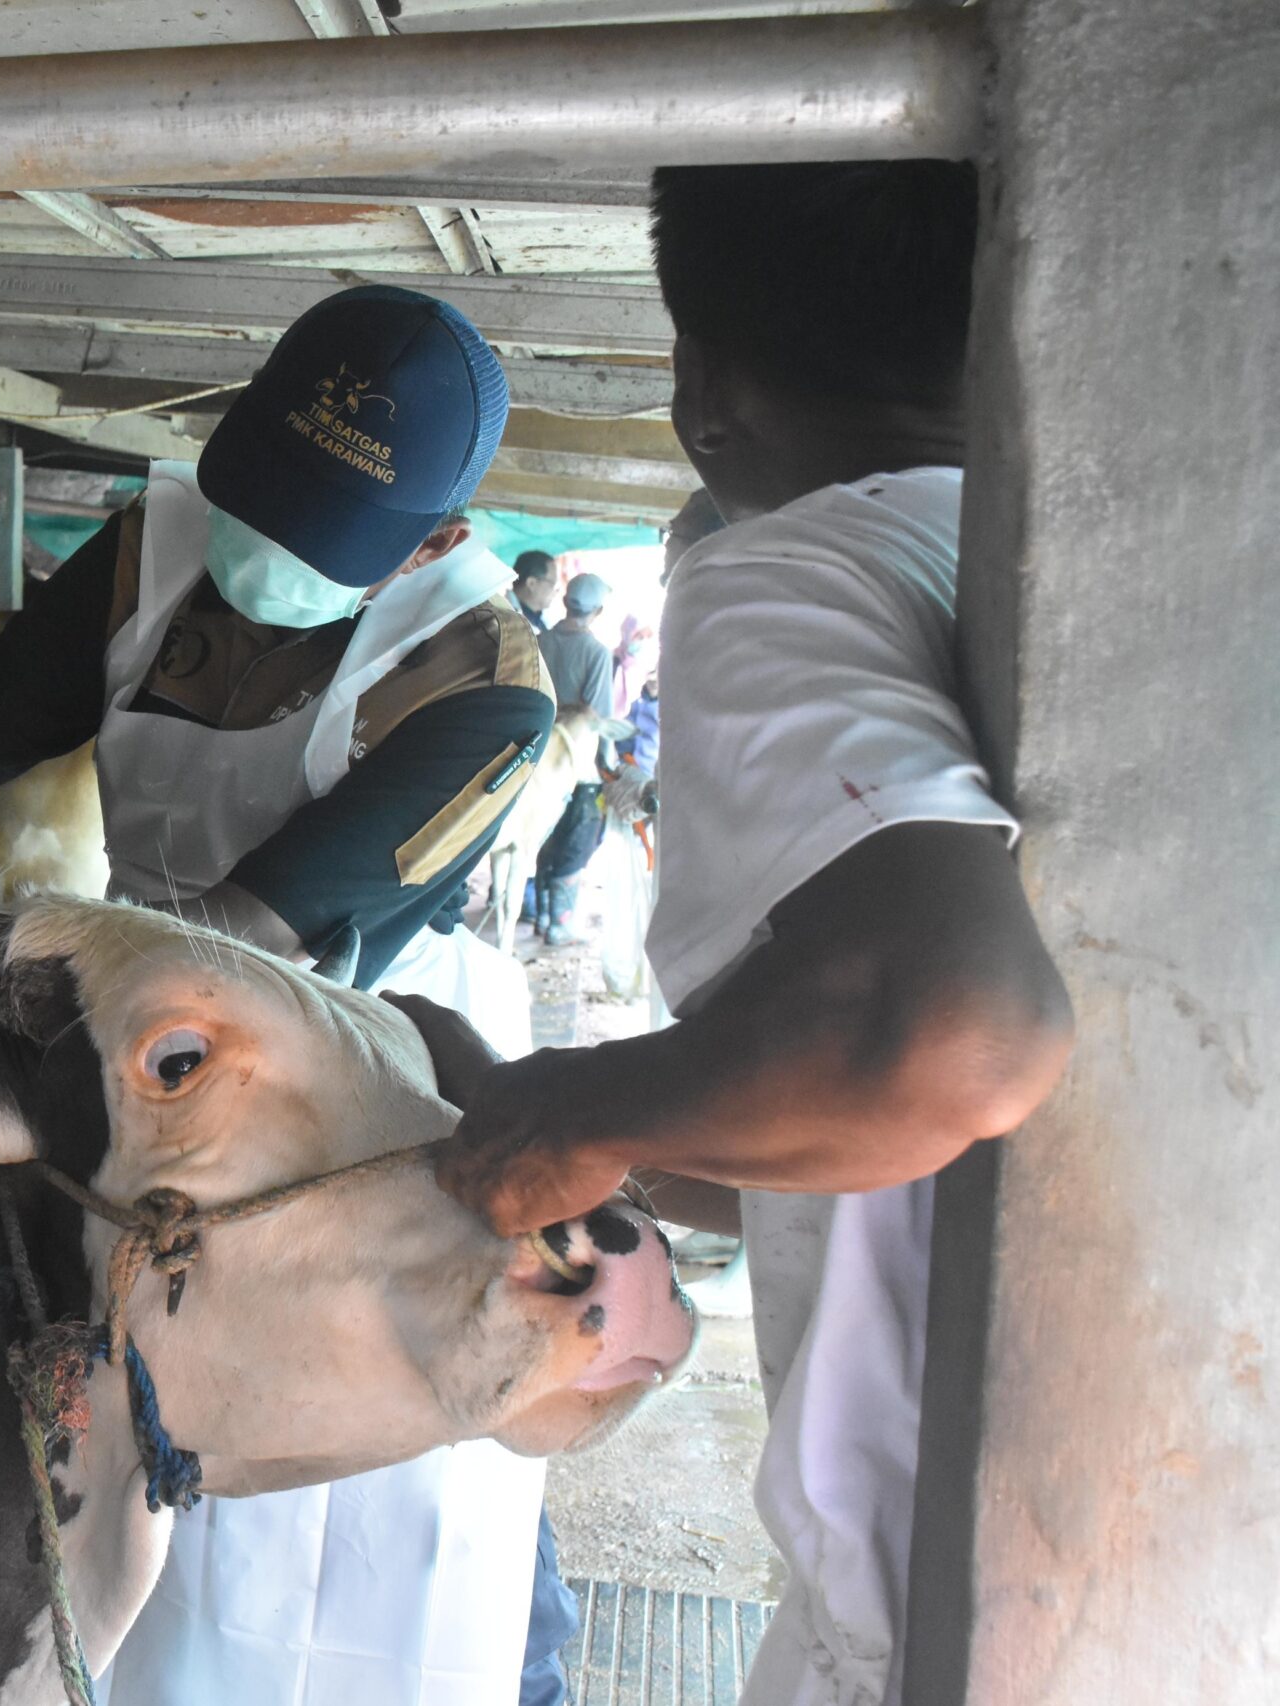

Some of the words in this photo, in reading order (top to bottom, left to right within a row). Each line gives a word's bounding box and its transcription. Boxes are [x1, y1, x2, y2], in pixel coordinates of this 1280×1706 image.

[285, 411, 315, 437] PMK
[313, 431, 396, 484] KARAWANG
[309, 402, 331, 427] TIM
[332, 420, 392, 460] SATGAS
